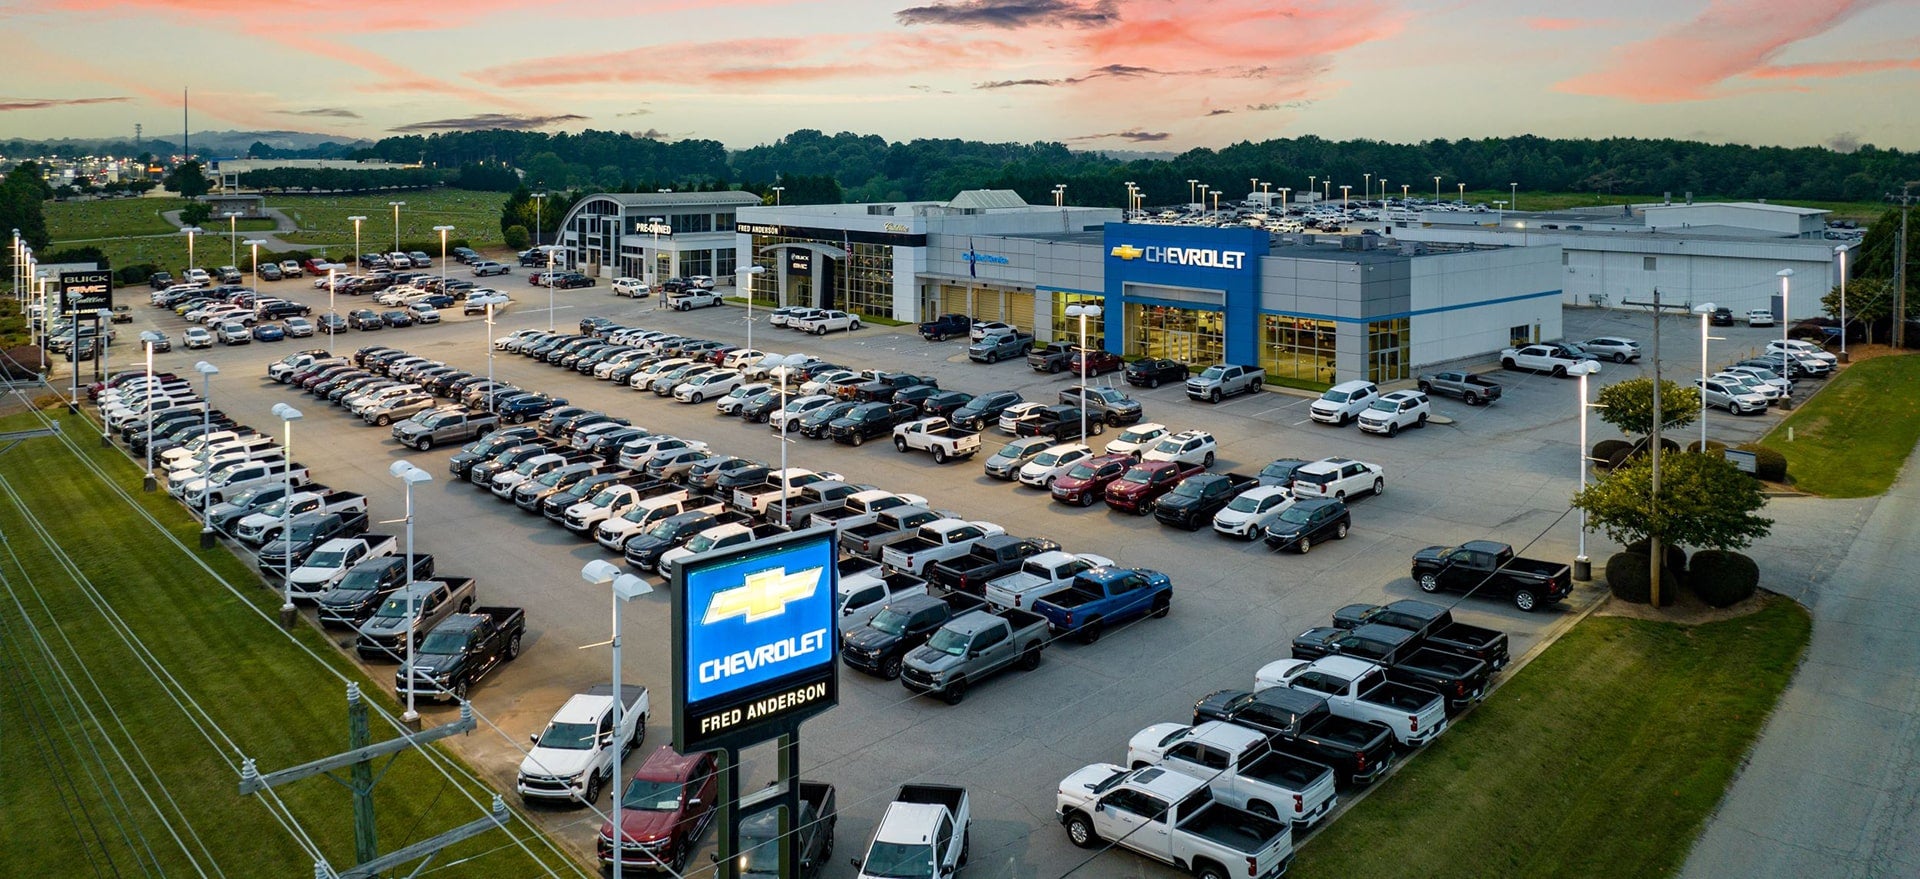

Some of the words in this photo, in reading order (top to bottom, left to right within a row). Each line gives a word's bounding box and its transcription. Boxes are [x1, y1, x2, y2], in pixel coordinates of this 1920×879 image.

[636, 223, 671, 234] PRE-OWNED
[752, 226, 779, 234] ANDERSON
[1145, 246, 1246, 269] CHEVROLET
[64, 275, 108, 283] BUICK
[66, 285, 107, 294] GMC
[699, 628, 827, 684] CHEVROLET
[701, 709, 742, 734] FRED
[746, 682, 826, 720] ANDERSON
